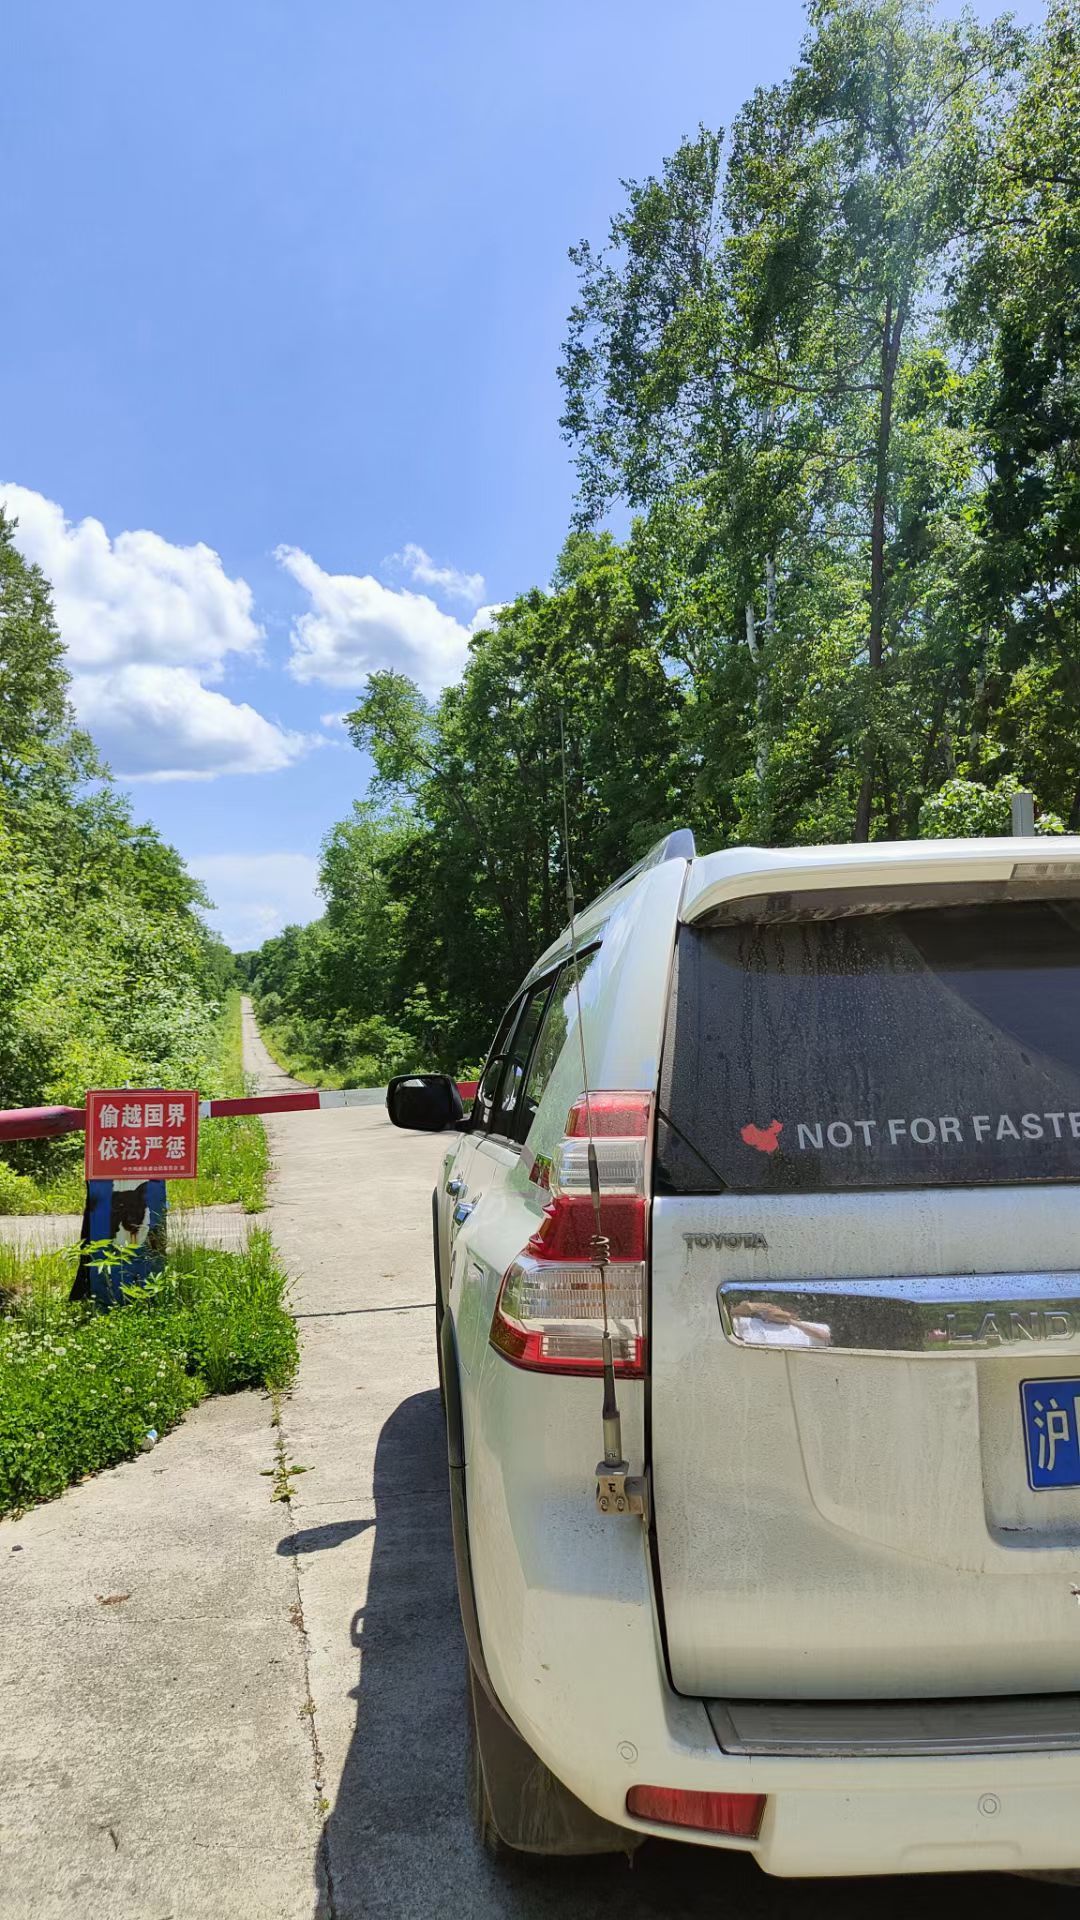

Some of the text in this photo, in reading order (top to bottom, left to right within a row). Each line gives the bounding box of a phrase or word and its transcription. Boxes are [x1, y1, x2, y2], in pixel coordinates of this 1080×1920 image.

[98, 1103, 187, 1129] 偷越国界
[797, 1120, 876, 1150] NOT
[887, 1117, 964, 1145] FOR
[97, 1135, 187, 1161] 依法严惩
[682, 1232, 769, 1250] TOYOTA
[946, 1311, 1077, 1345] LAND
